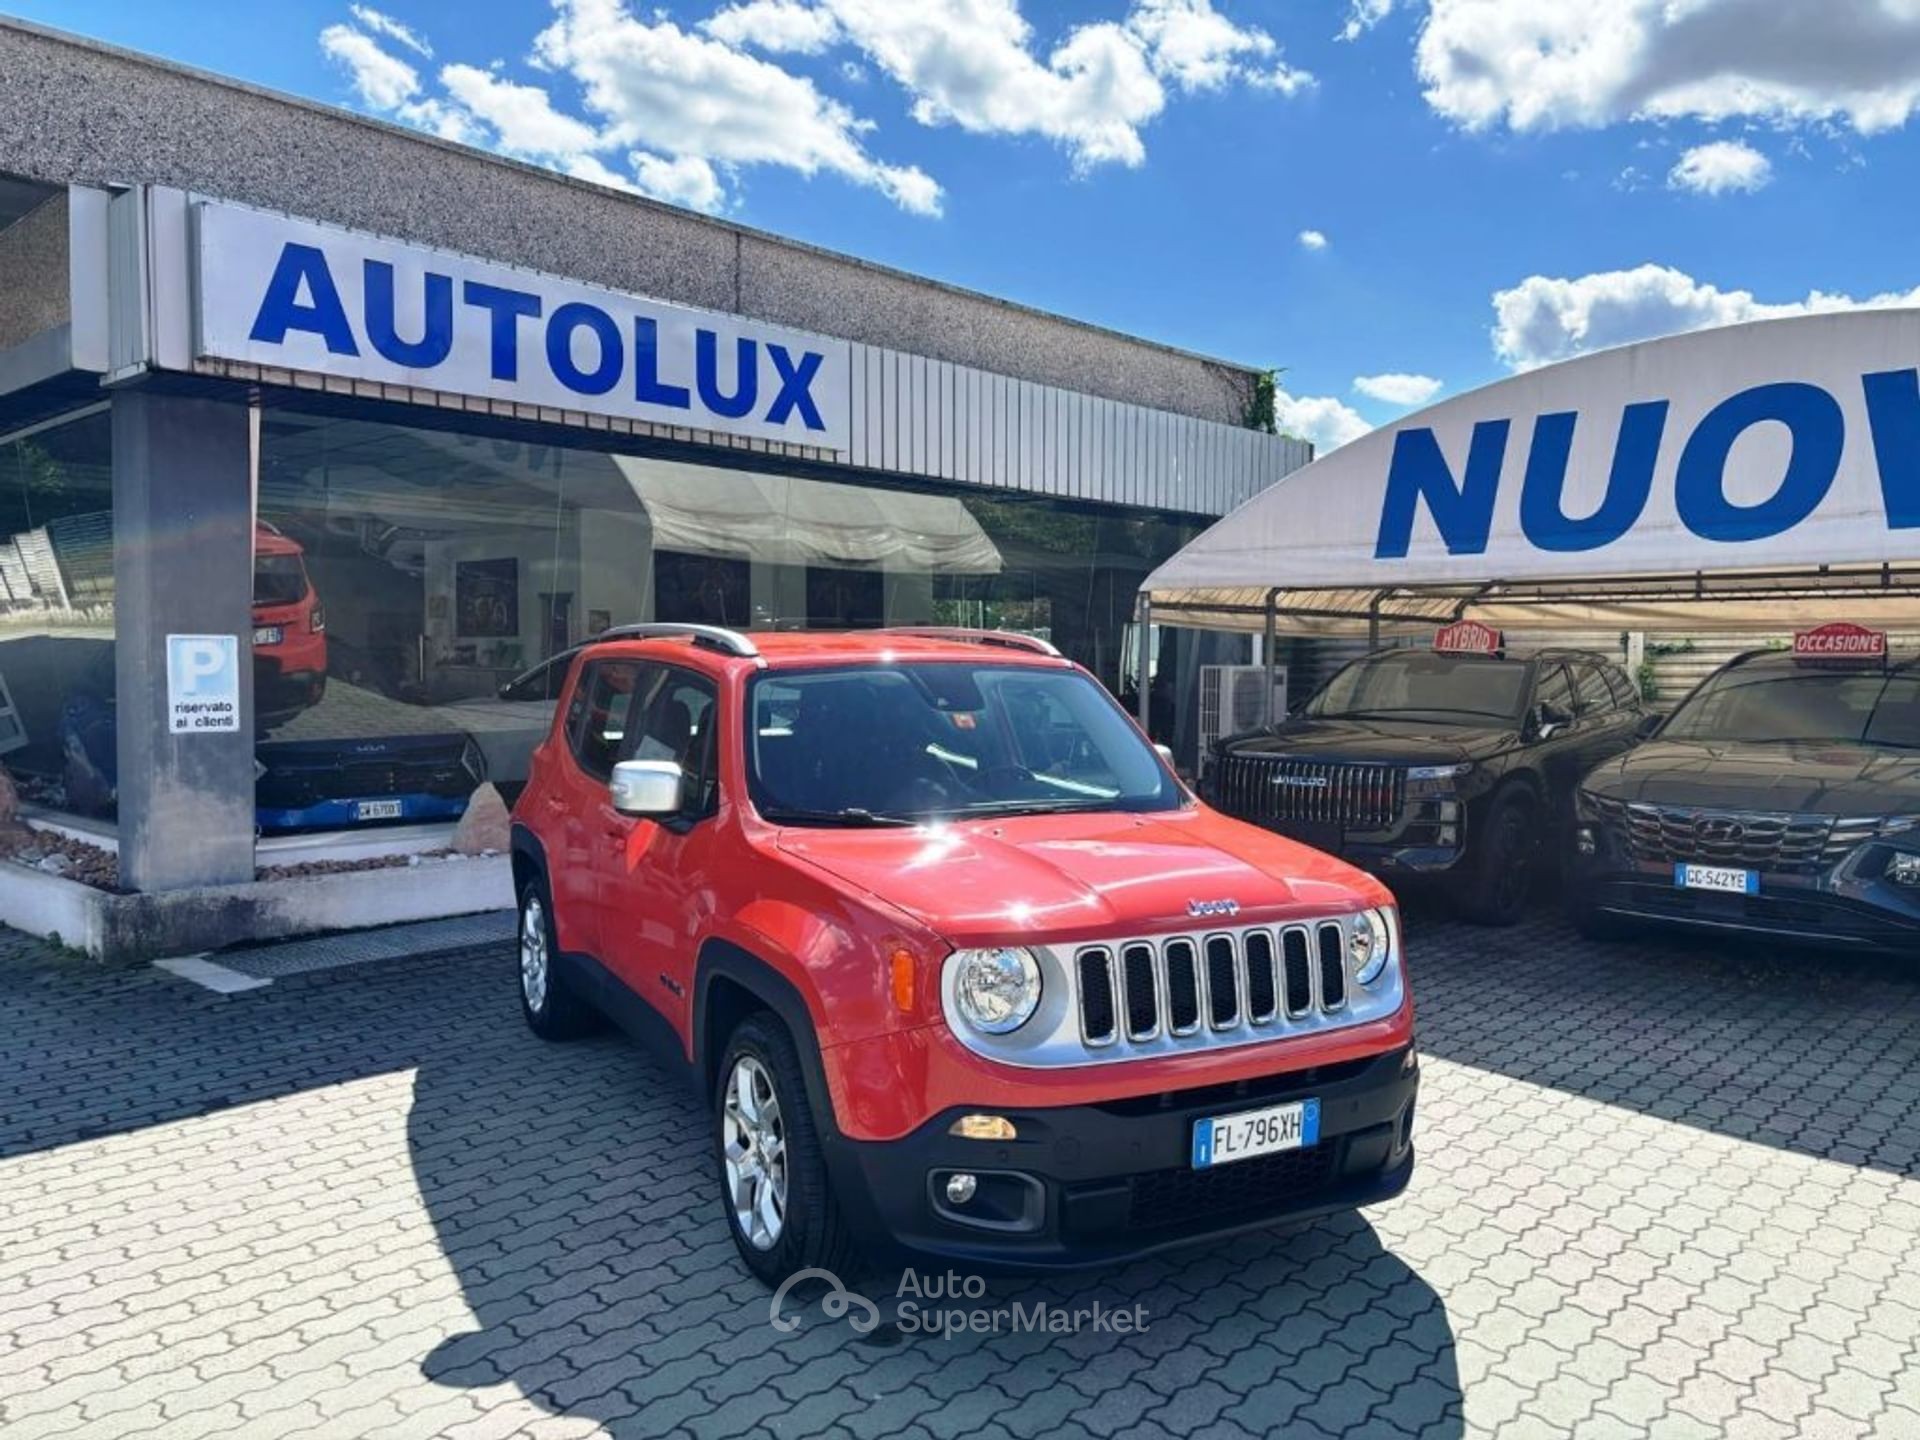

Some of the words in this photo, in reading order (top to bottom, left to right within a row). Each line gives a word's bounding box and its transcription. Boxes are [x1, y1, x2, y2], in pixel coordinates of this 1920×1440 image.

[248, 241, 827, 432] AUTOLUX
[1441, 624, 1490, 650] HYBRID
[1797, 635, 1882, 651] OCCASIONE
[175, 701, 233, 714] riservato
[176, 717, 188, 729] ai
[194, 716, 234, 728] clienti
[1187, 898, 1240, 917] Jeep
